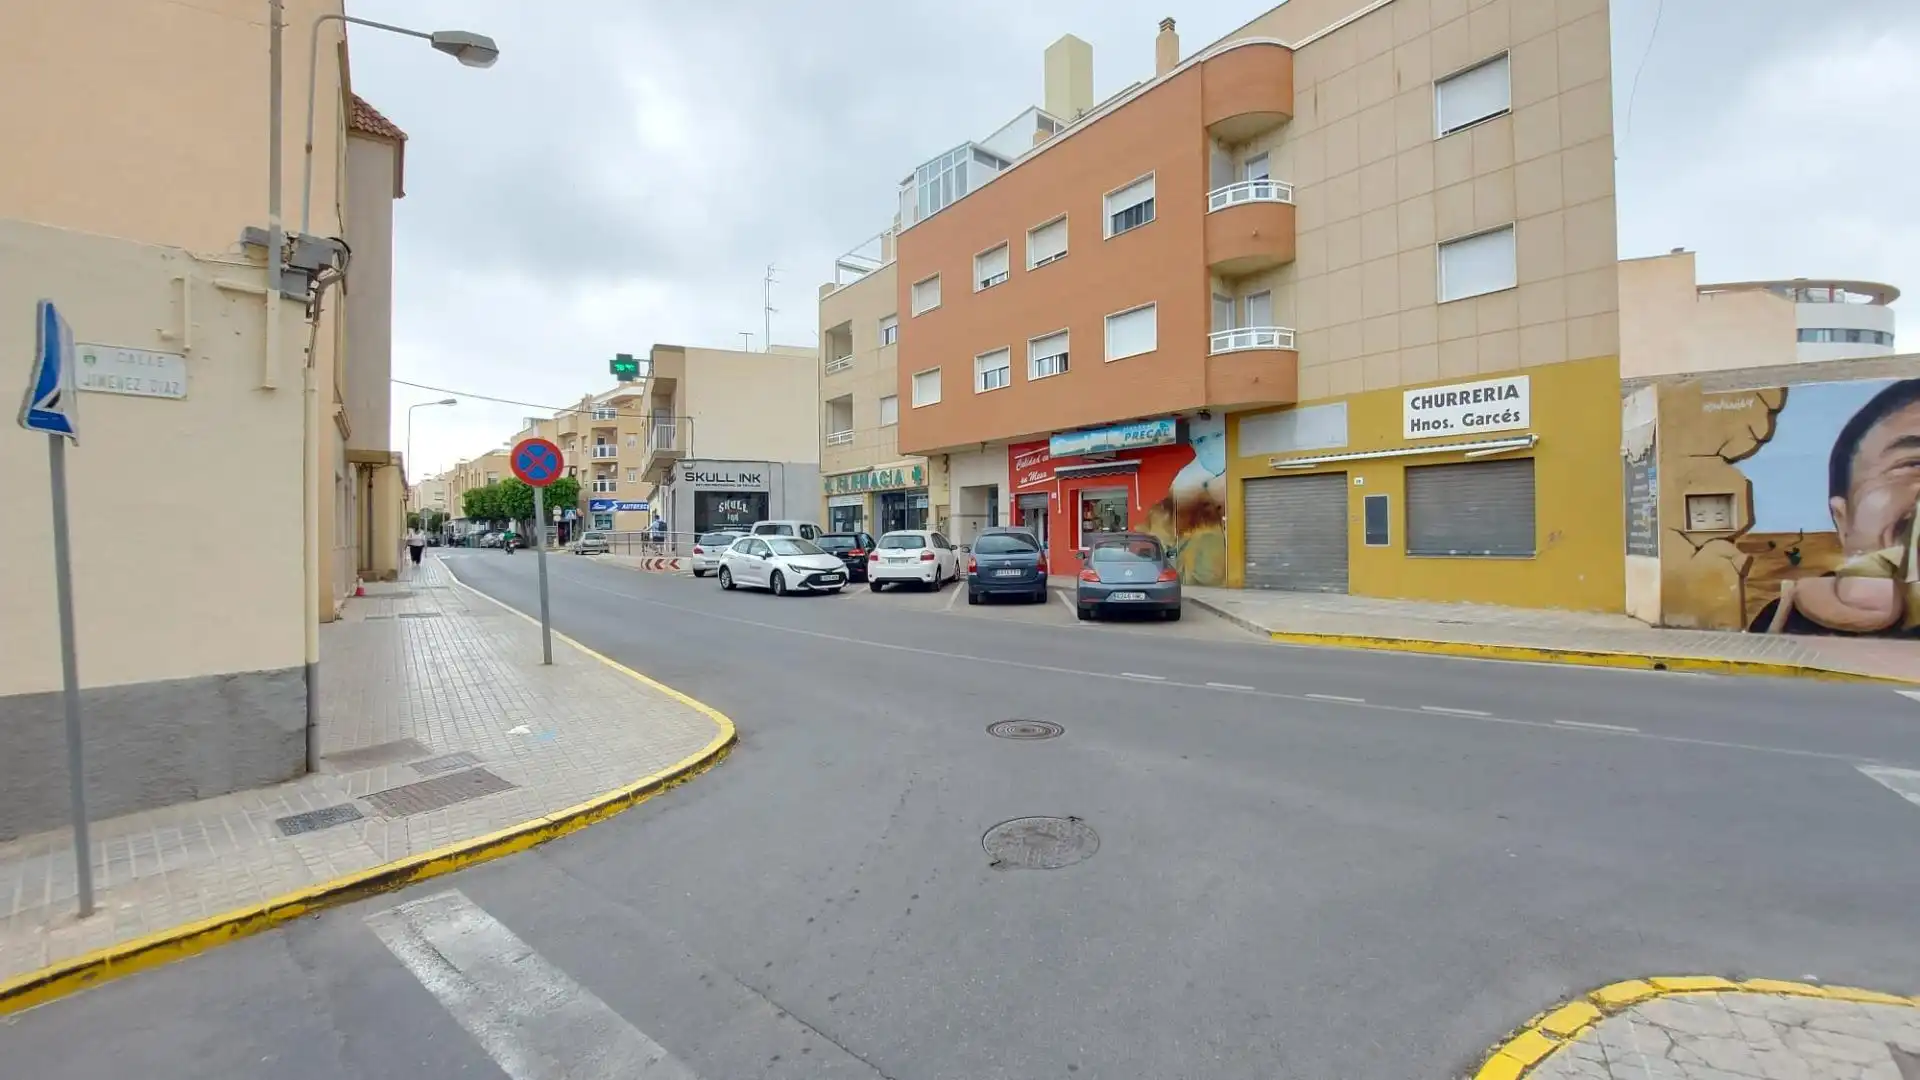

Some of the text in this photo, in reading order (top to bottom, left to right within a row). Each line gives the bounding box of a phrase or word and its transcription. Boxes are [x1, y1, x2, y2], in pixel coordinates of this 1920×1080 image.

[117, 351, 166, 368] CALLE
[1410, 384, 1520, 410] CHURRERIA
[1410, 408, 1521, 433] Hnos. Garcés
[685, 472, 761, 483] SKULL INK
[718, 499, 749, 514] SKULL
